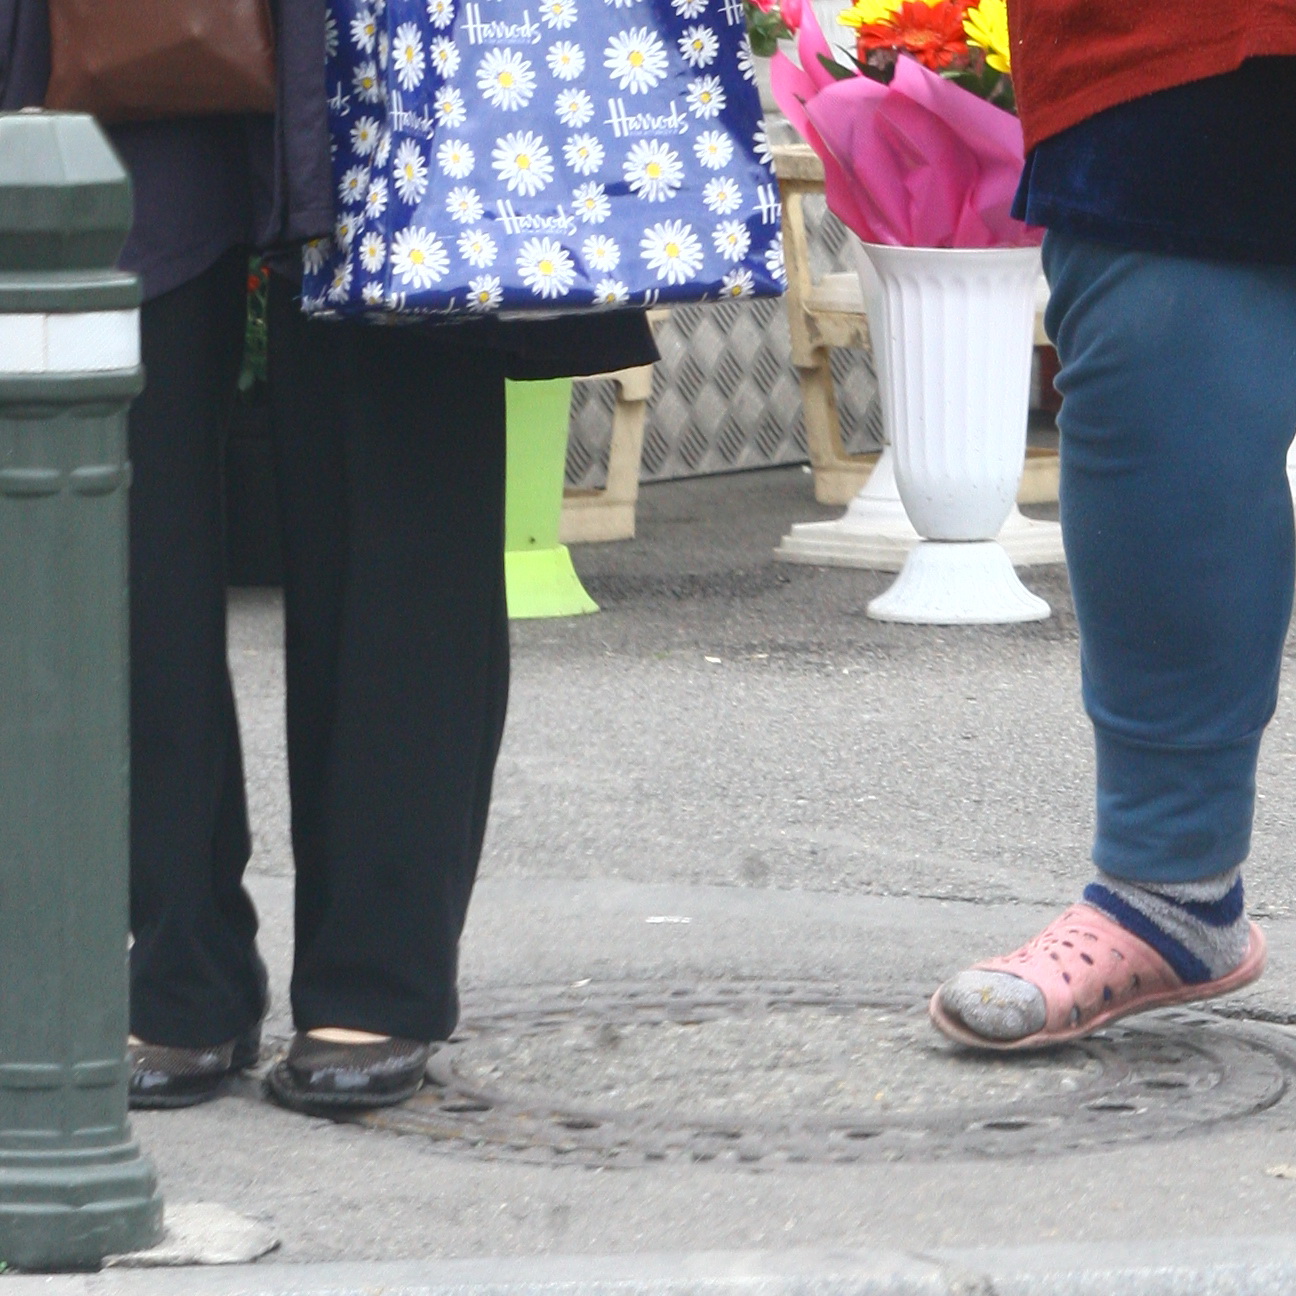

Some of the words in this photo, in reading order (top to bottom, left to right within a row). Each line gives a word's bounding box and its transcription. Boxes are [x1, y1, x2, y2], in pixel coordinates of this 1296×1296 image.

[461, 2, 542, 45] Harrods
[603, 97, 689, 138] Harrods
[495, 199, 577, 237] Harrods
